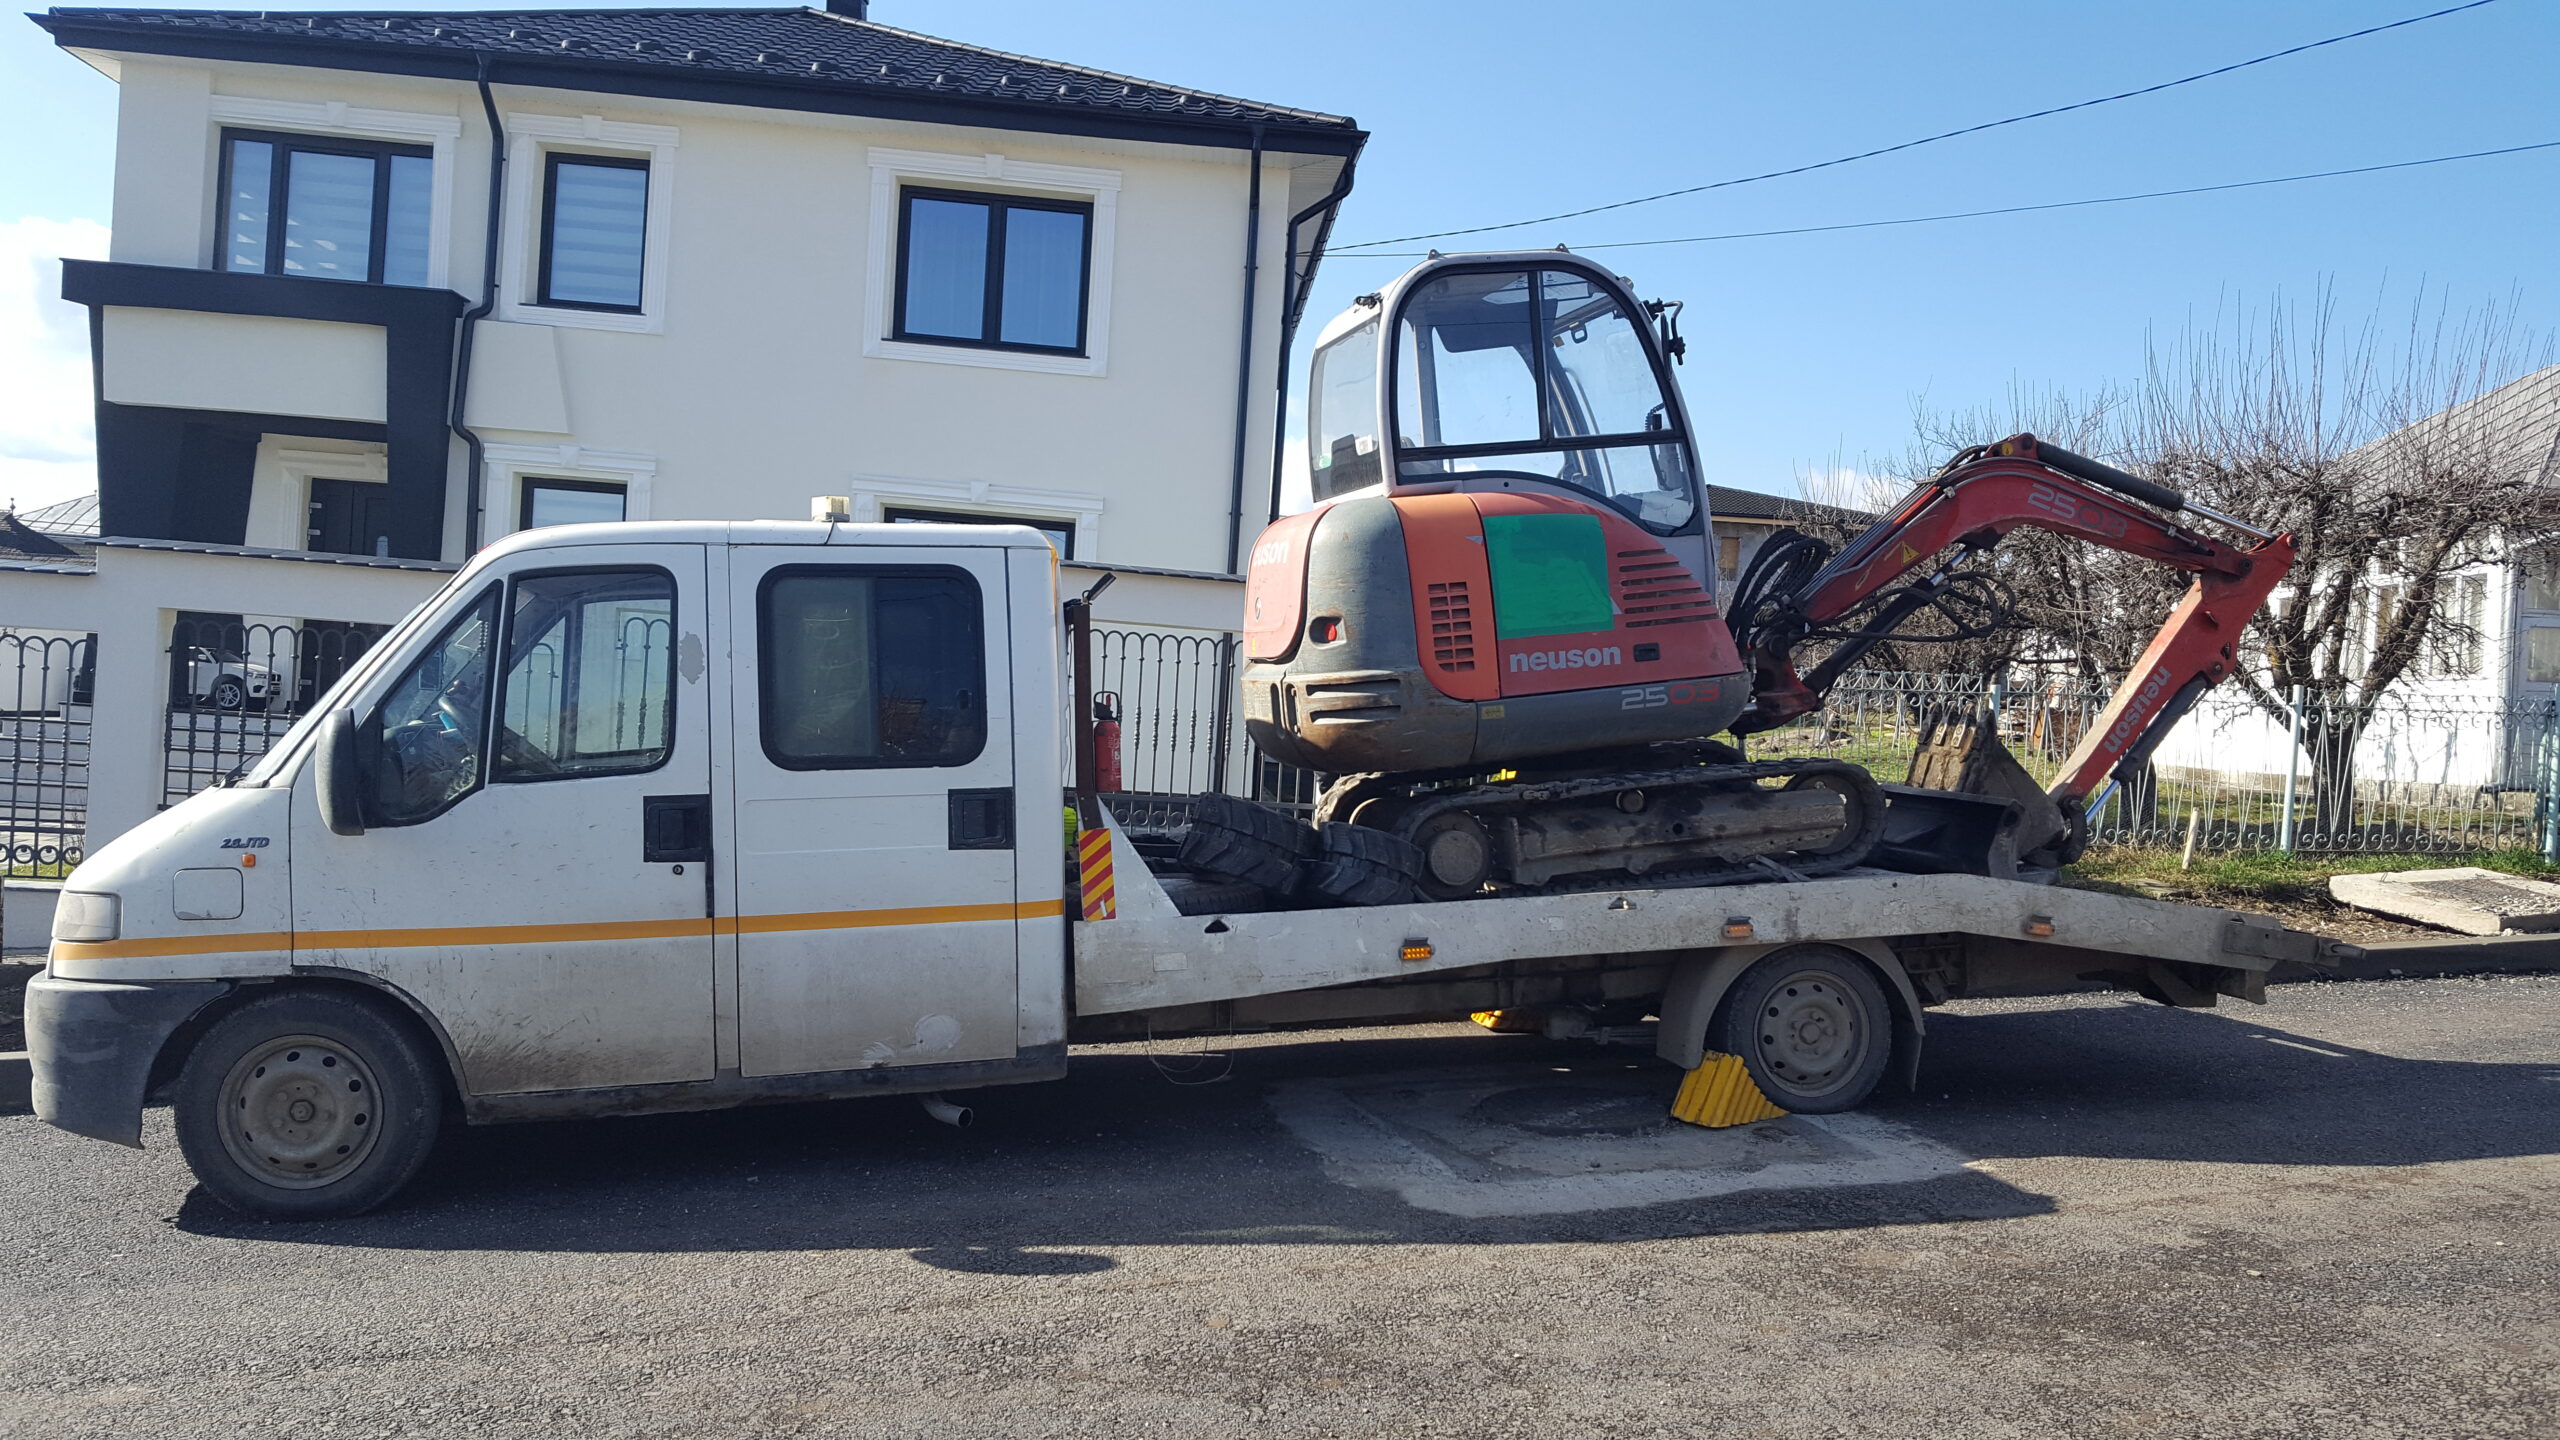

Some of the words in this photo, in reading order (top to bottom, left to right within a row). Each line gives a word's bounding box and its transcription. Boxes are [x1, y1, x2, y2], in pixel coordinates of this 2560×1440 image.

[2028, 483, 2128, 538] 2503
[1509, 646, 1621, 673] neuson
[1621, 682, 1721, 710] 2503
[2103, 666, 2172, 753] neuson
